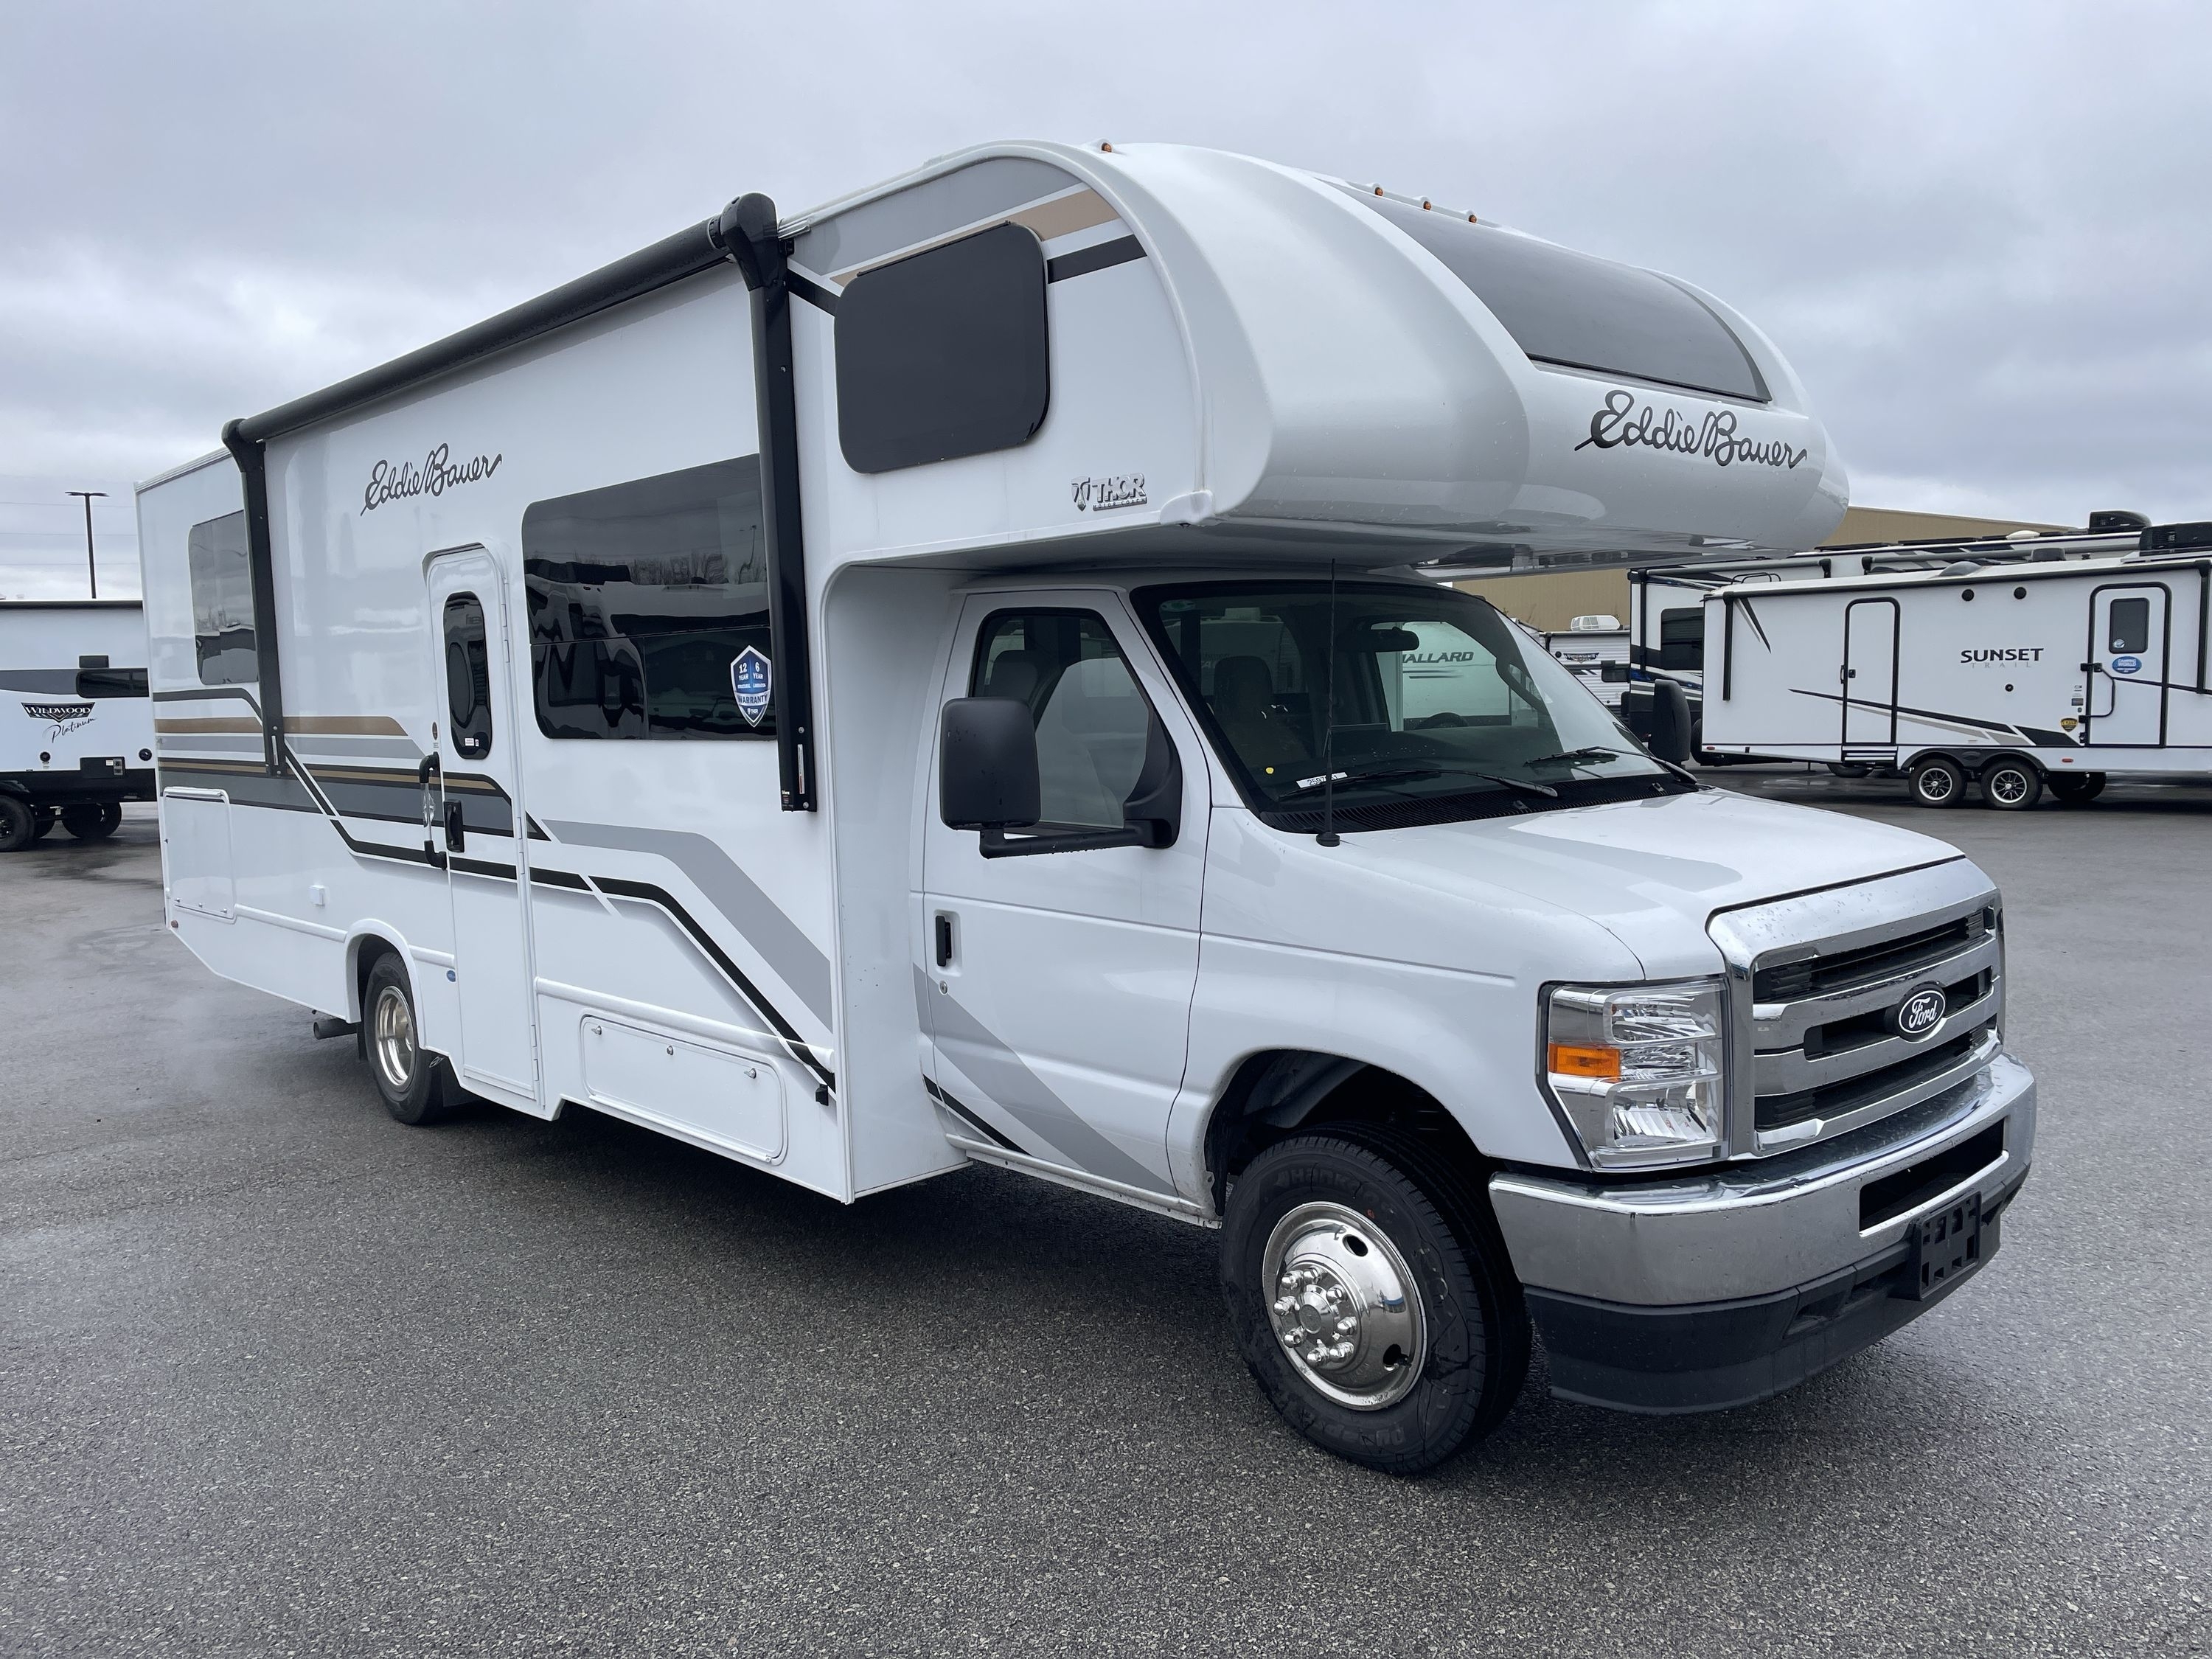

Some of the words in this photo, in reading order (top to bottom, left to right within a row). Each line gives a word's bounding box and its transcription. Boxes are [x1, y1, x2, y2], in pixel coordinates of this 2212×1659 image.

[1574, 390, 1698, 451] Eddie
[1700, 411, 1807, 469] Bauer
[361, 459, 423, 516] Eddie
[424, 443, 502, 496] Bauer
[1092, 473, 1147, 503] THOR
[1961, 648, 2045, 664] SUNSET
[739, 662, 748, 674] 12
[755, 661, 760, 672] 6
[739, 673, 749, 681] YEAR
[753, 672, 763, 680] YEAR
[737, 694, 768, 704] WARRANTY
[43, 717, 96, 743] Platinum
[1908, 996, 1938, 1029] Ford
